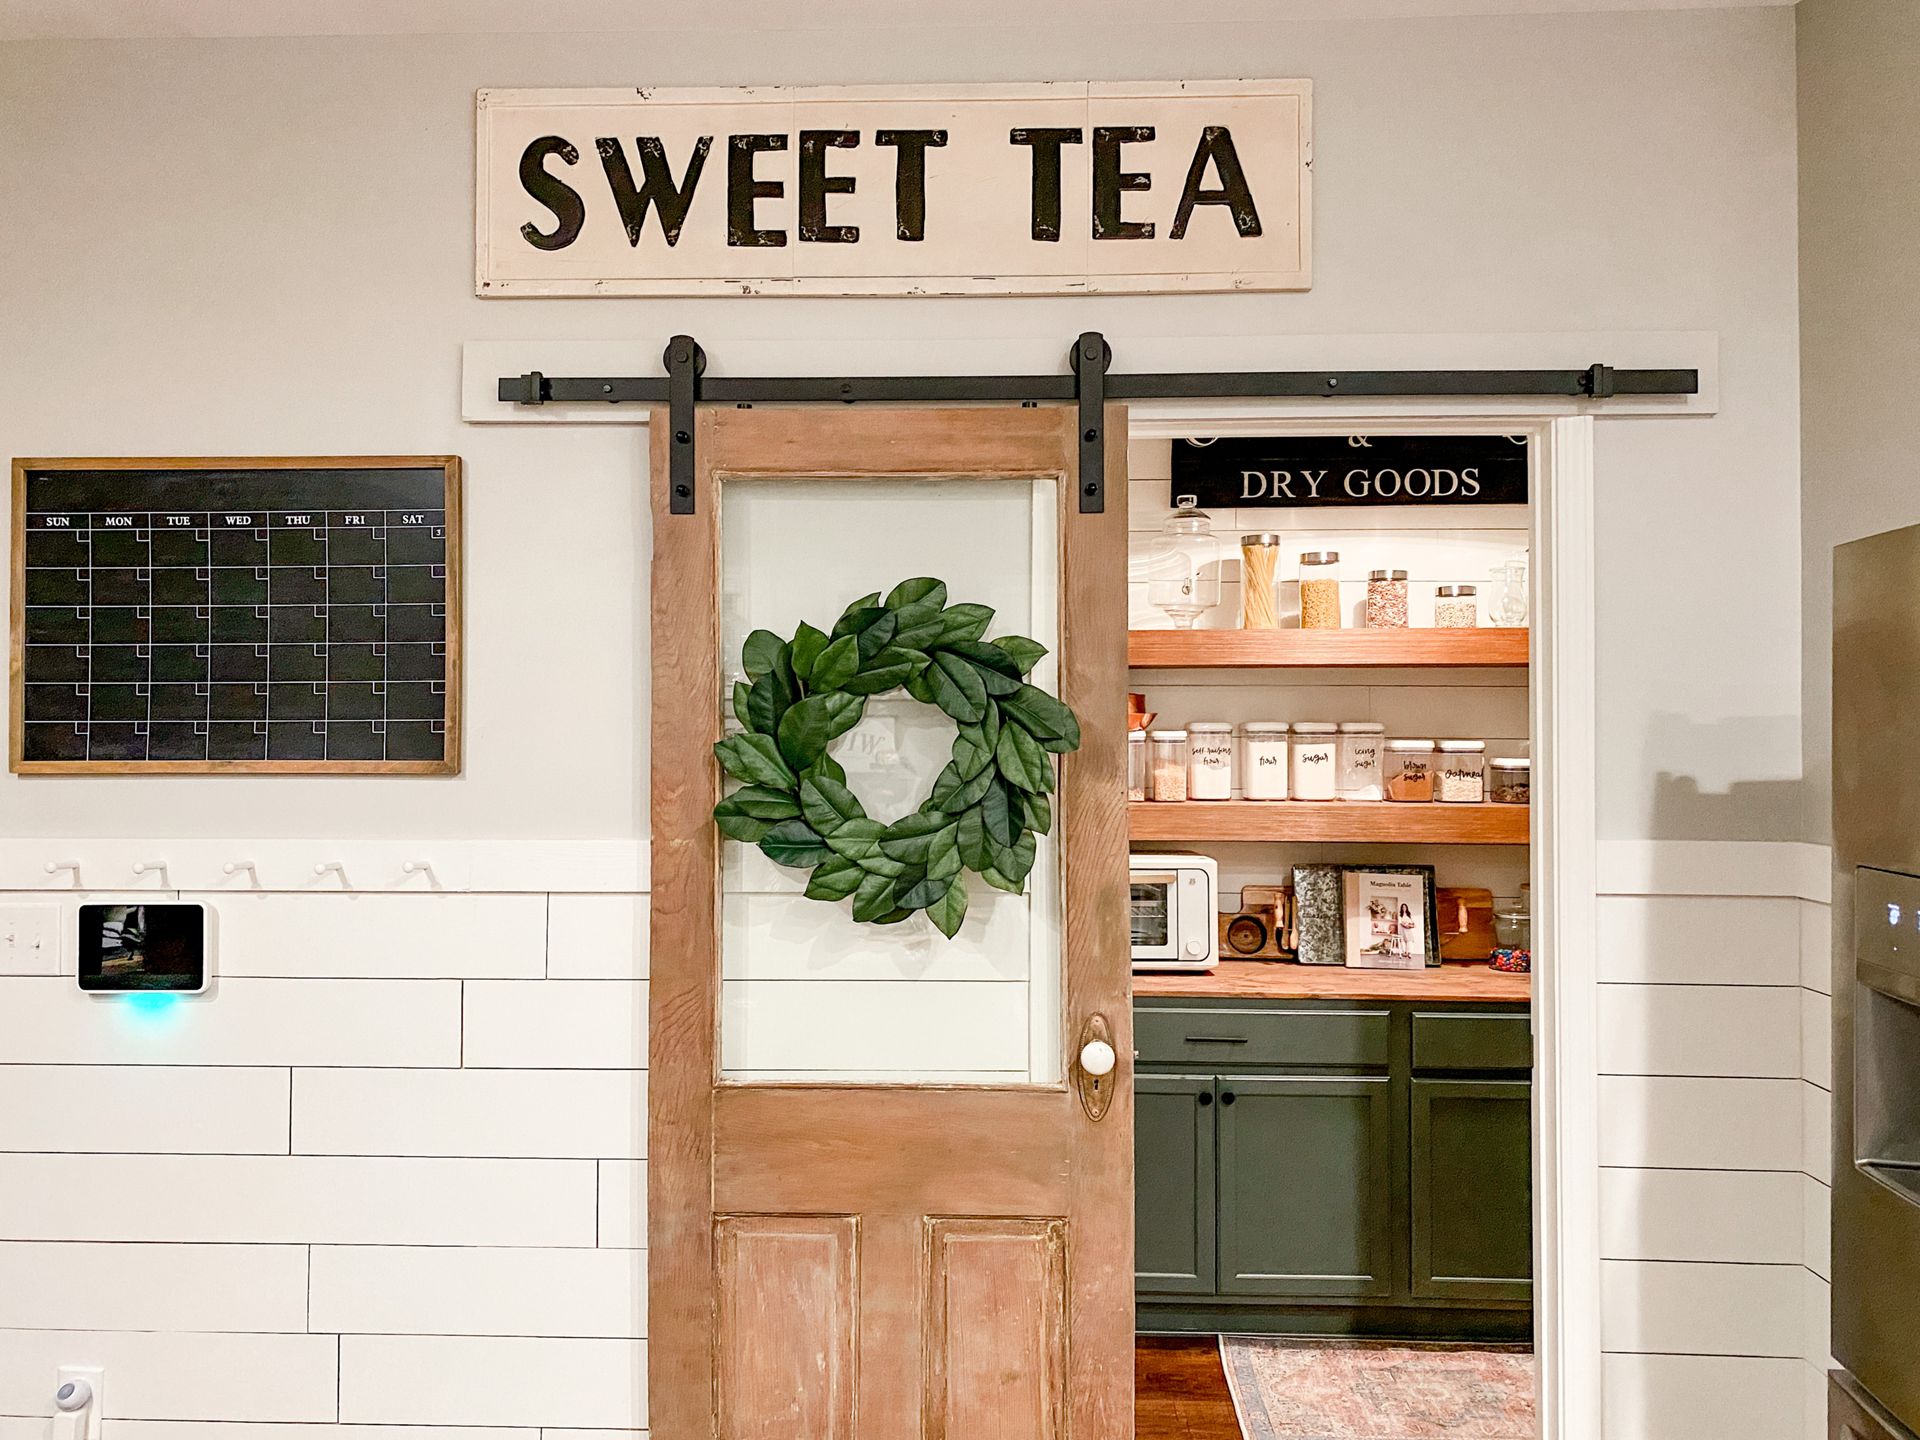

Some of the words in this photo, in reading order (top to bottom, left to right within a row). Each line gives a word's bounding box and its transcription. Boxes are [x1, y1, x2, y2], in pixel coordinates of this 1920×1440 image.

[519, 130, 949, 251] SWEET
[1009, 126, 1264, 242] TEA
[1239, 470, 1329, 499] DRY
[1343, 468, 1481, 498] GOODS
[46, 517, 70, 527] SUN
[105, 516, 133, 526] MON
[166, 516, 191, 526] TUE
[225, 515, 252, 525] WED
[285, 515, 311, 525] THU
[344, 515, 365, 525] FRI
[402, 514, 425, 524] SAT
[1302, 753, 1329, 765] sugar
[1403, 773, 1426, 782] sugar
[1370, 880, 1396, 888] Magnolia
